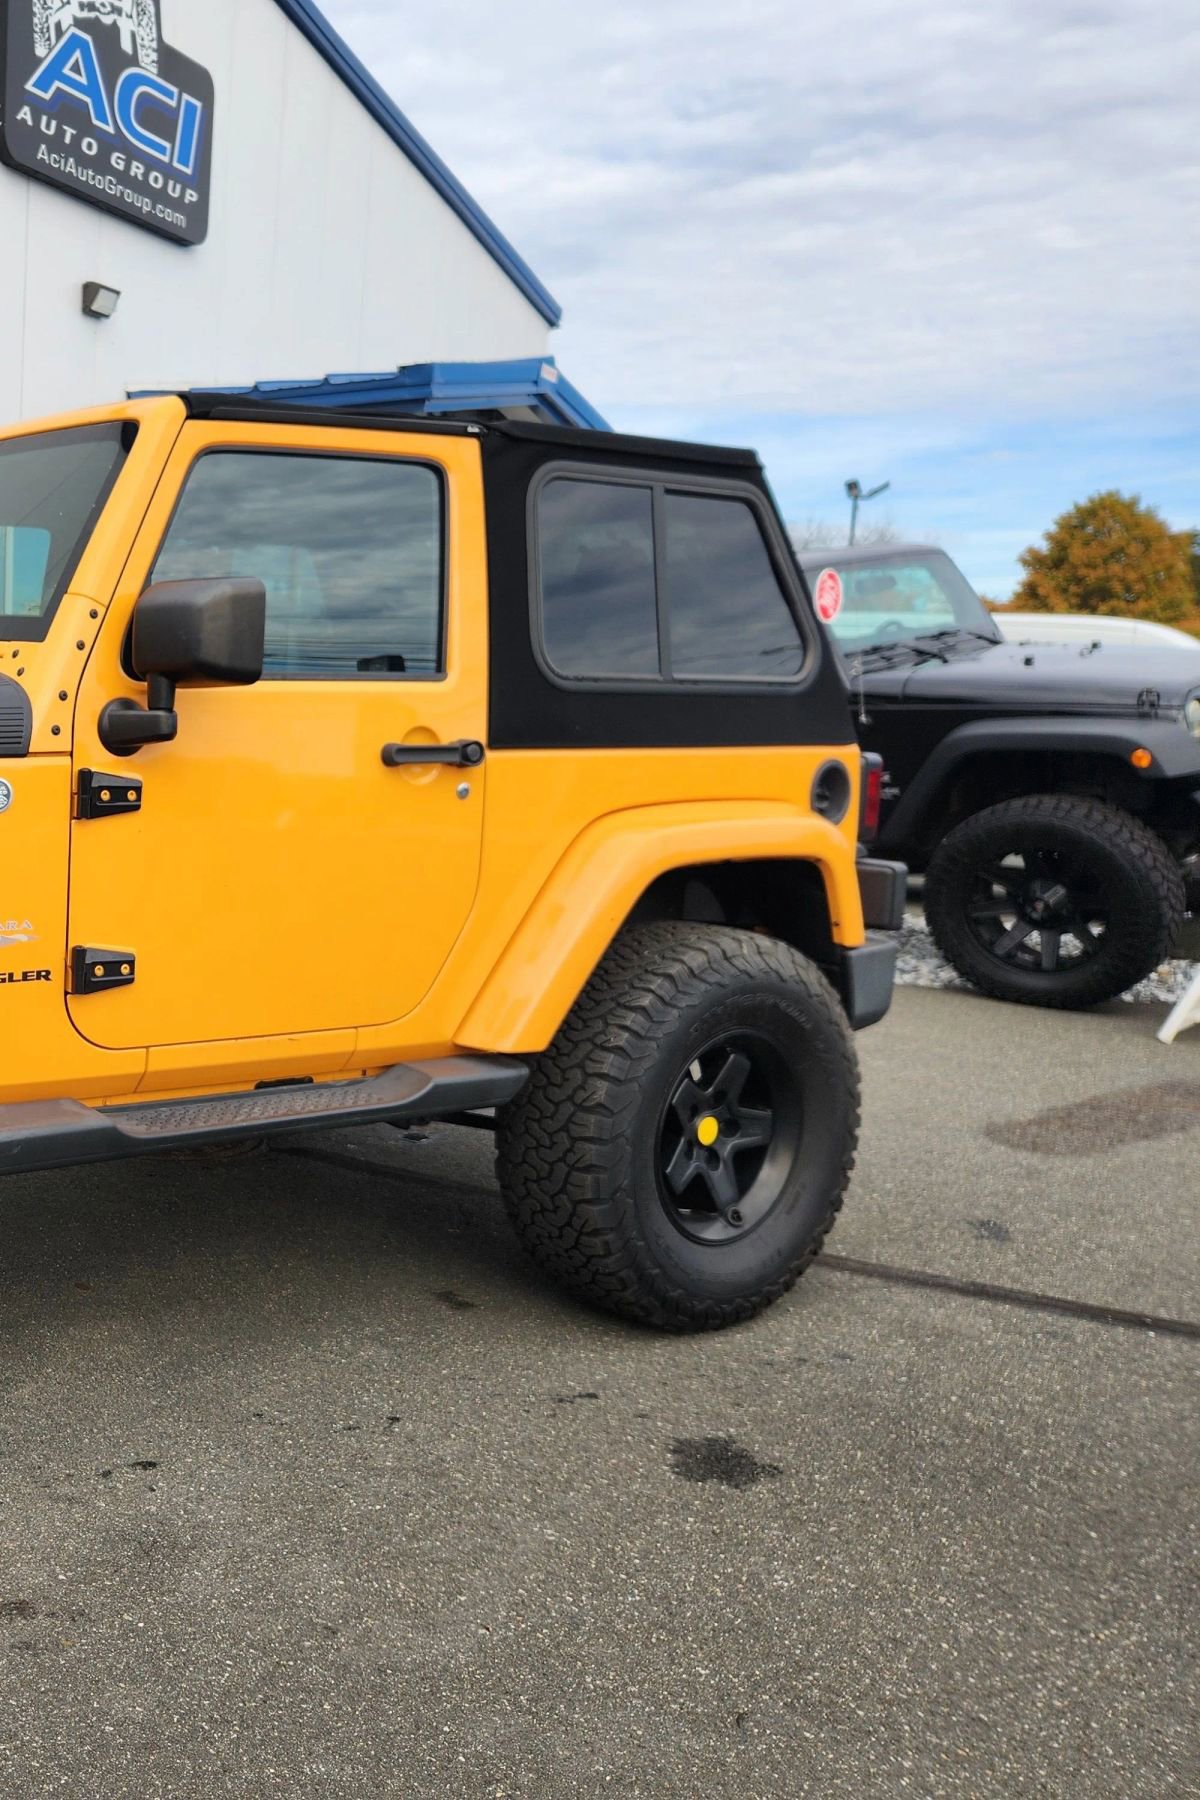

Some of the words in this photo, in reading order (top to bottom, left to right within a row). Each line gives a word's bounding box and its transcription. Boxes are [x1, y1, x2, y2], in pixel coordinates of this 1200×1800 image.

[24, 25, 202, 176] ACI
[16, 104, 98, 157] AUTO
[110, 151, 199, 204] GROUP
[36, 143, 187, 229] AciAutoGroup.com
